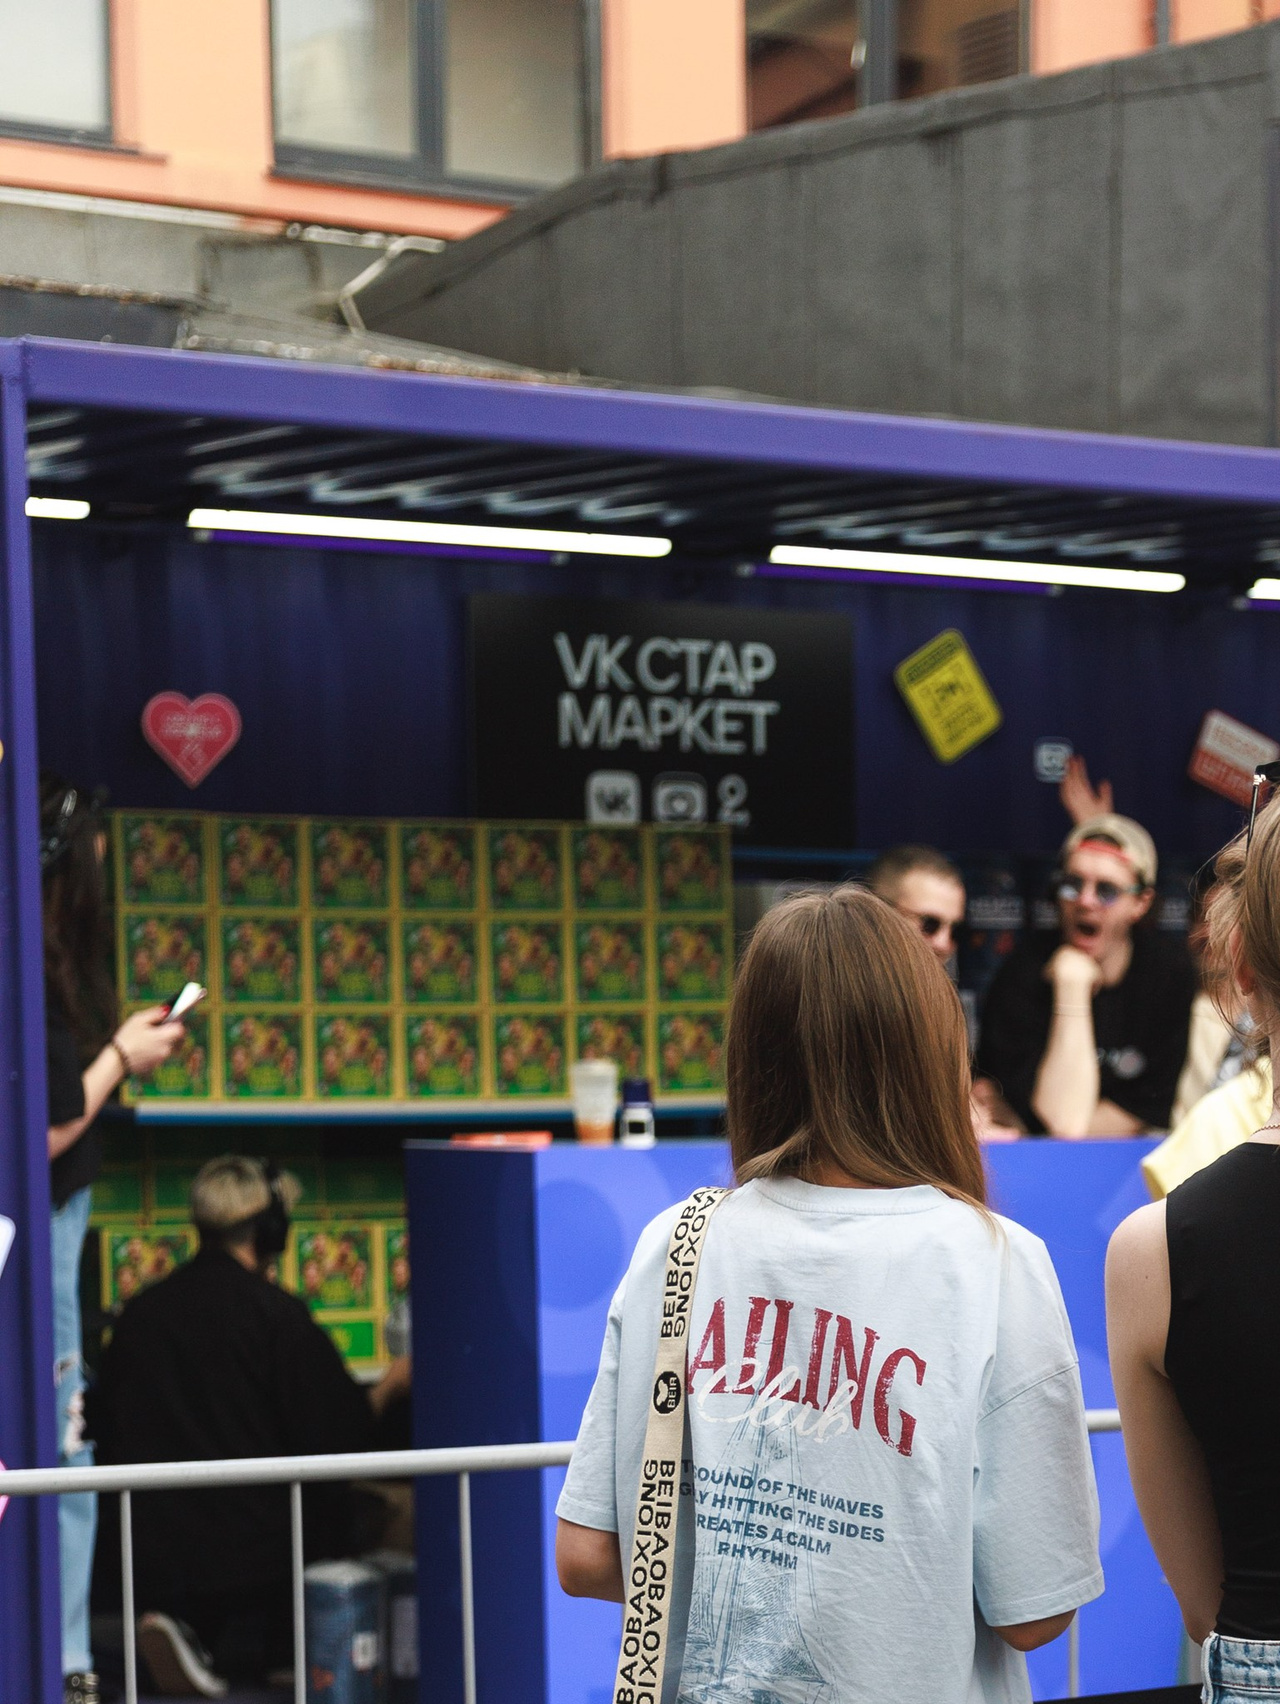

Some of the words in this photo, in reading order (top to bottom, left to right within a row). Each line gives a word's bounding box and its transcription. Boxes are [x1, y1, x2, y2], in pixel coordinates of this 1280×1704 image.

[553, 631, 635, 692] VK
[636, 636, 778, 697] СТАР
[558, 691, 781, 755] МАРКЕТ
[661, 1186, 711, 1338] BEIBAOBA
[686, 1296, 928, 1457] AILING
[697, 1356, 859, 1443] Club
[711, 1493, 794, 1521] HITTING
[797, 1510, 826, 1531] THE
[827, 1519, 886, 1543] SIDES
[757, 1478, 784, 1495] OF
[786, 1483, 818, 1504] THE
[820, 1493, 884, 1519] WAVES
[696, 1513, 769, 1540] REATES
[770, 1527, 784, 1543] A
[786, 1531, 832, 1555] CALM
[717, 1541, 798, 1570] RHYTHM
